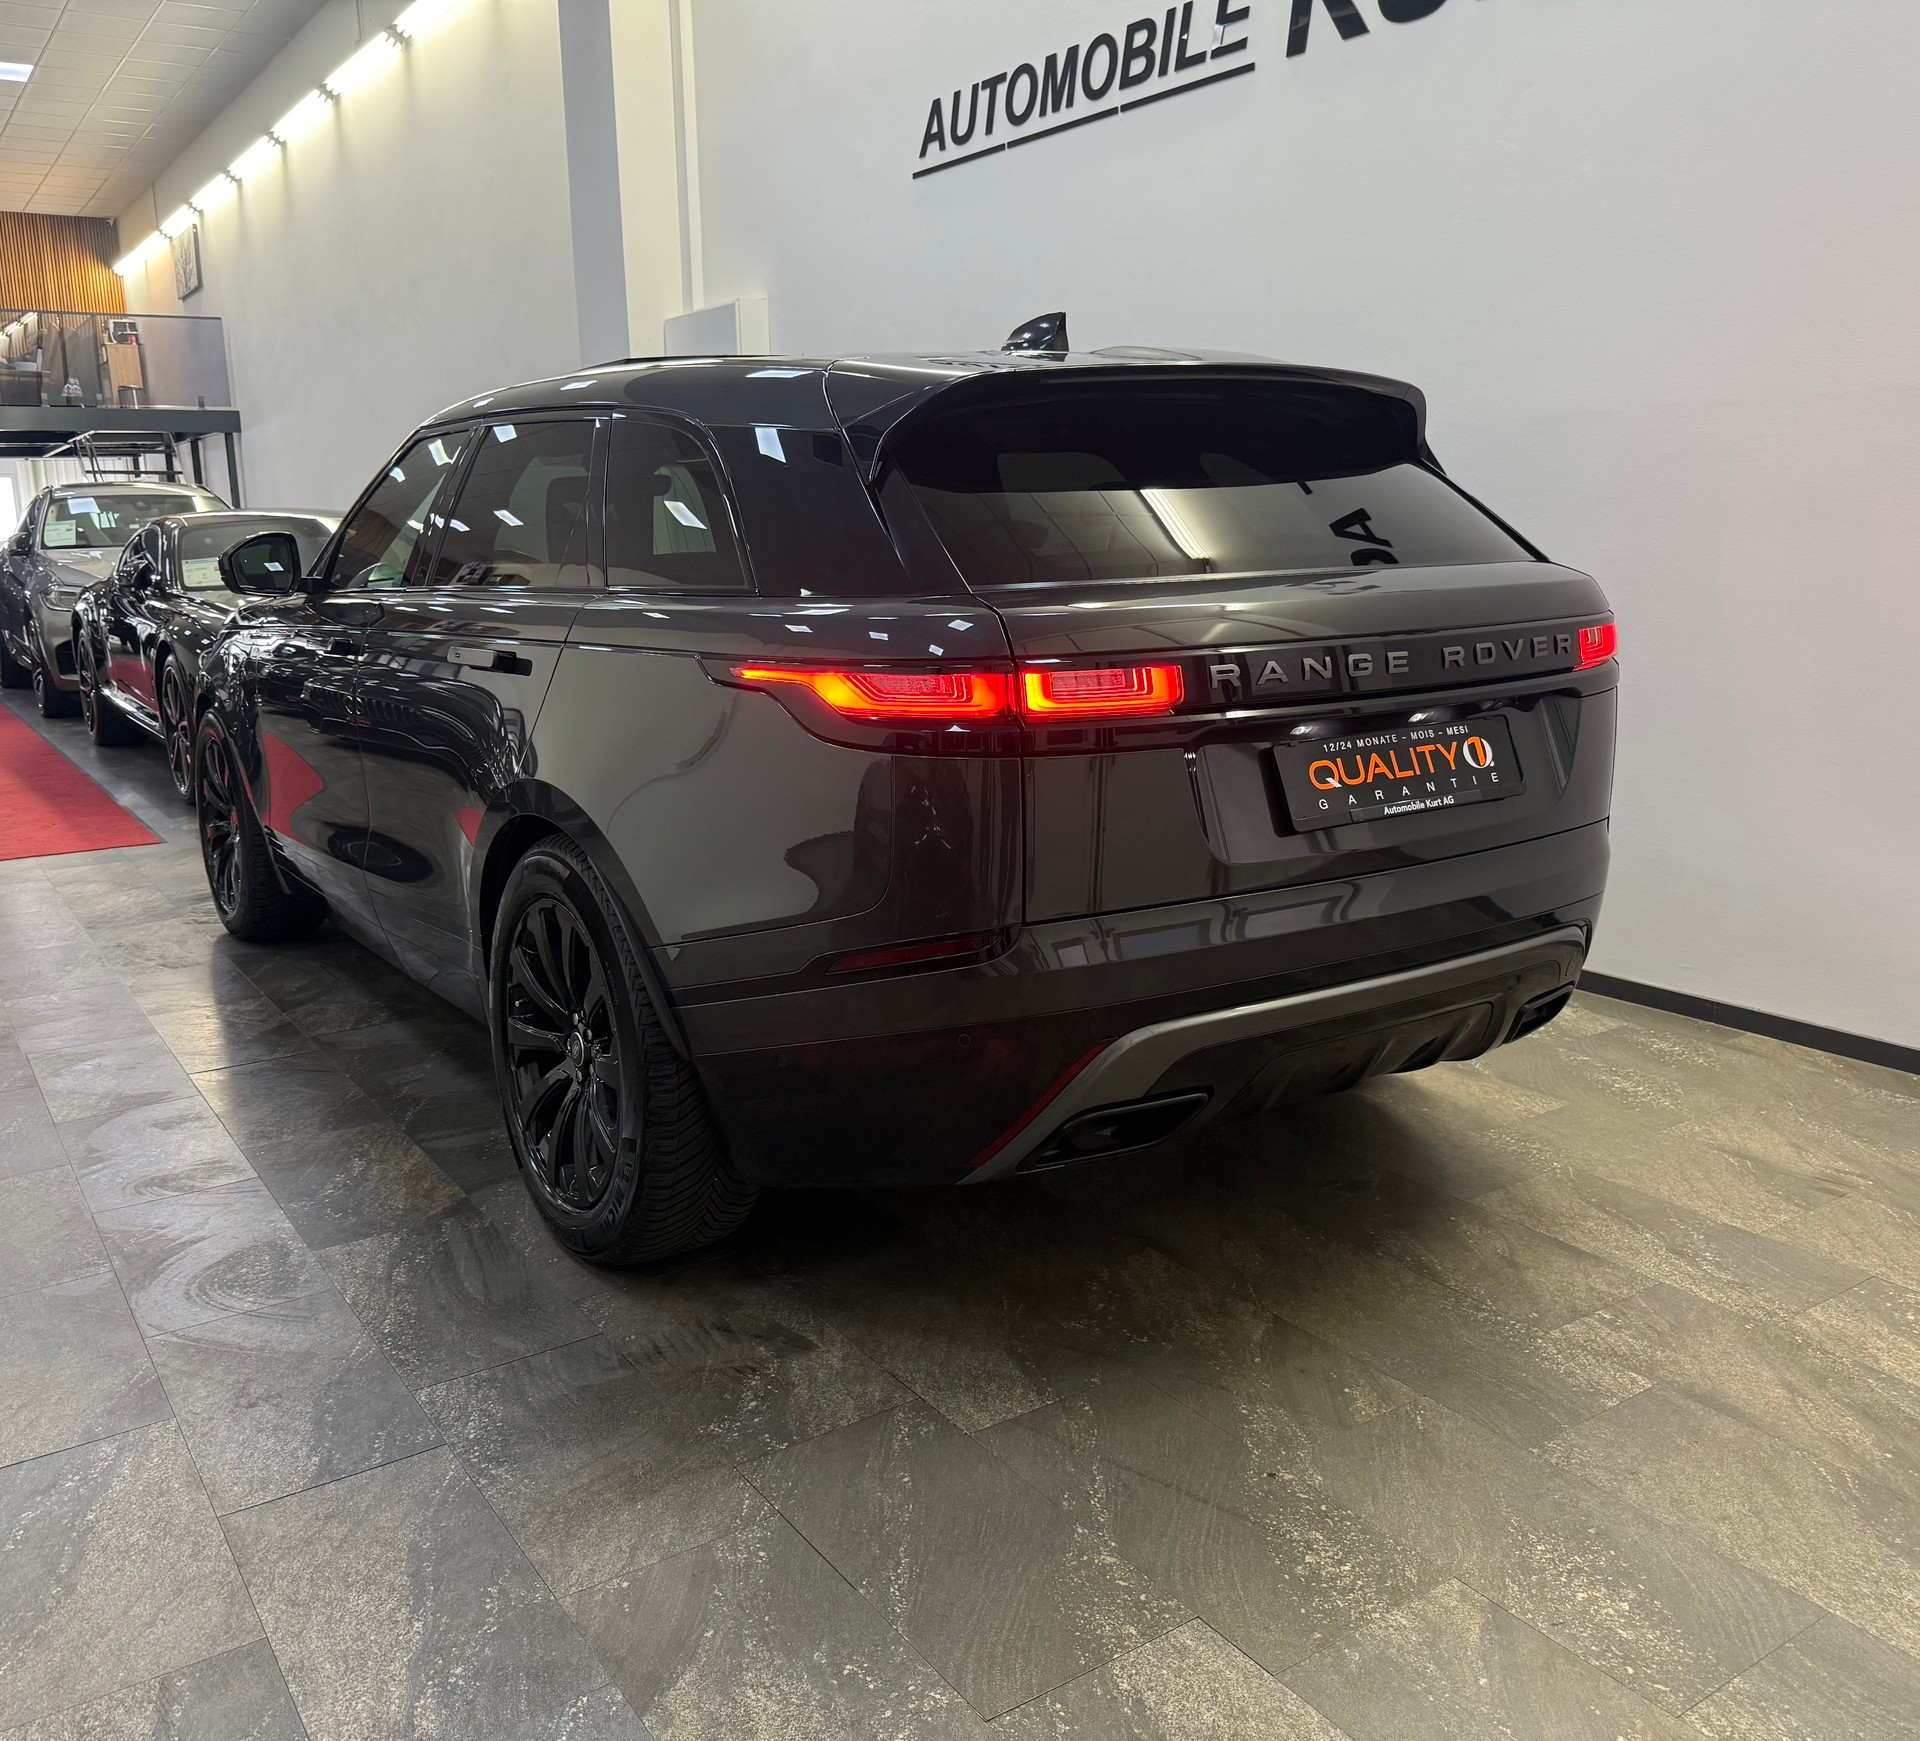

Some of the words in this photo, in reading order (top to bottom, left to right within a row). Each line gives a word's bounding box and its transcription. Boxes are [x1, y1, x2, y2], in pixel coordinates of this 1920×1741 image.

[919, 0, 1250, 159] AUTOMOBILE
[1209, 651, 1409, 689] RANGE
[1441, 633, 1572, 669] ROVER
[1323, 741, 1352, 753] 12/24
[1356, 734, 1398, 748] MONATE
[1410, 729, 1435, 741] MOIS
[1446, 725, 1469, 736] MESI
[1308, 741, 1458, 791] QUALITY
[1318, 772, 1499, 810] GARANTIE
[1384, 801, 1425, 815] Automobile
[1426, 798, 1442, 808] Kurt
[1443, 795, 1455, 805] AG
